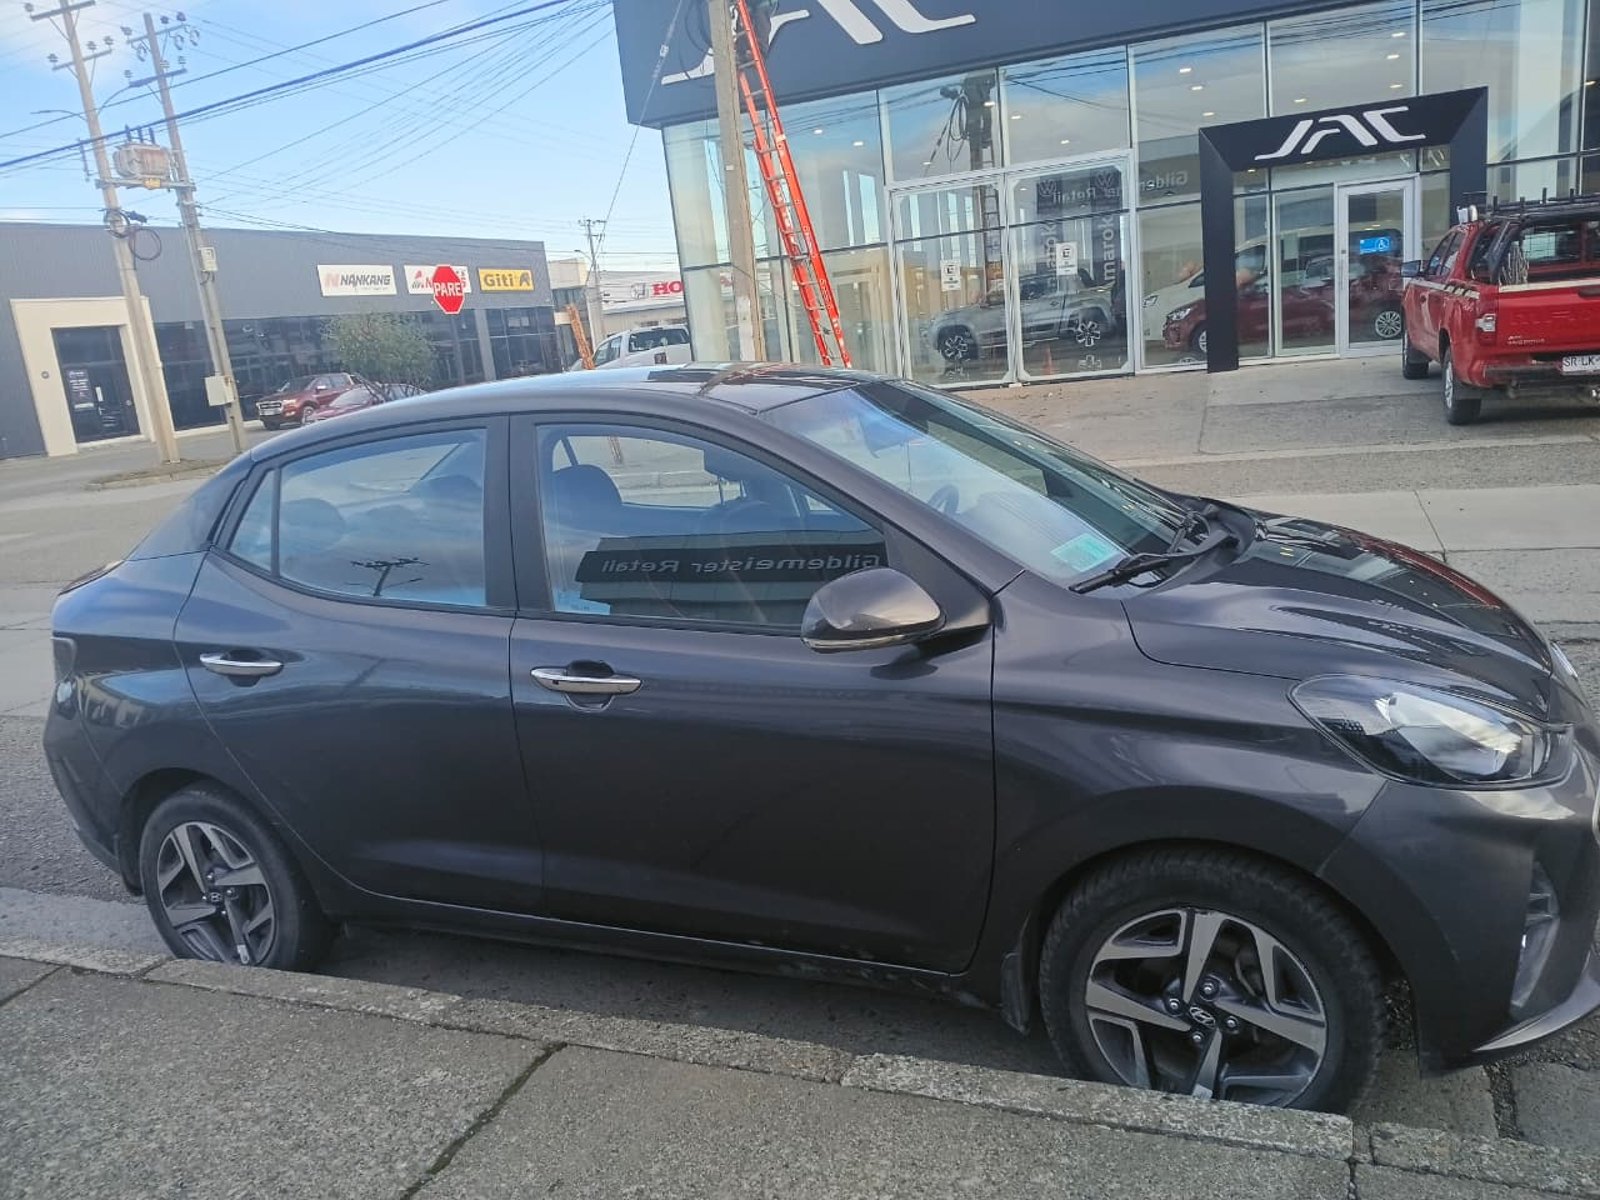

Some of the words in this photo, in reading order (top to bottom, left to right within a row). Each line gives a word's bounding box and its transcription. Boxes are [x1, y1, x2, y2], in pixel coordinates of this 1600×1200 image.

[1254, 106, 1426, 160] JAC
[340, 274, 391, 286] NANKANG
[484, 273, 514, 287] Giti
[652, 280, 685, 296] HO
[434, 281, 463, 297] PARE
